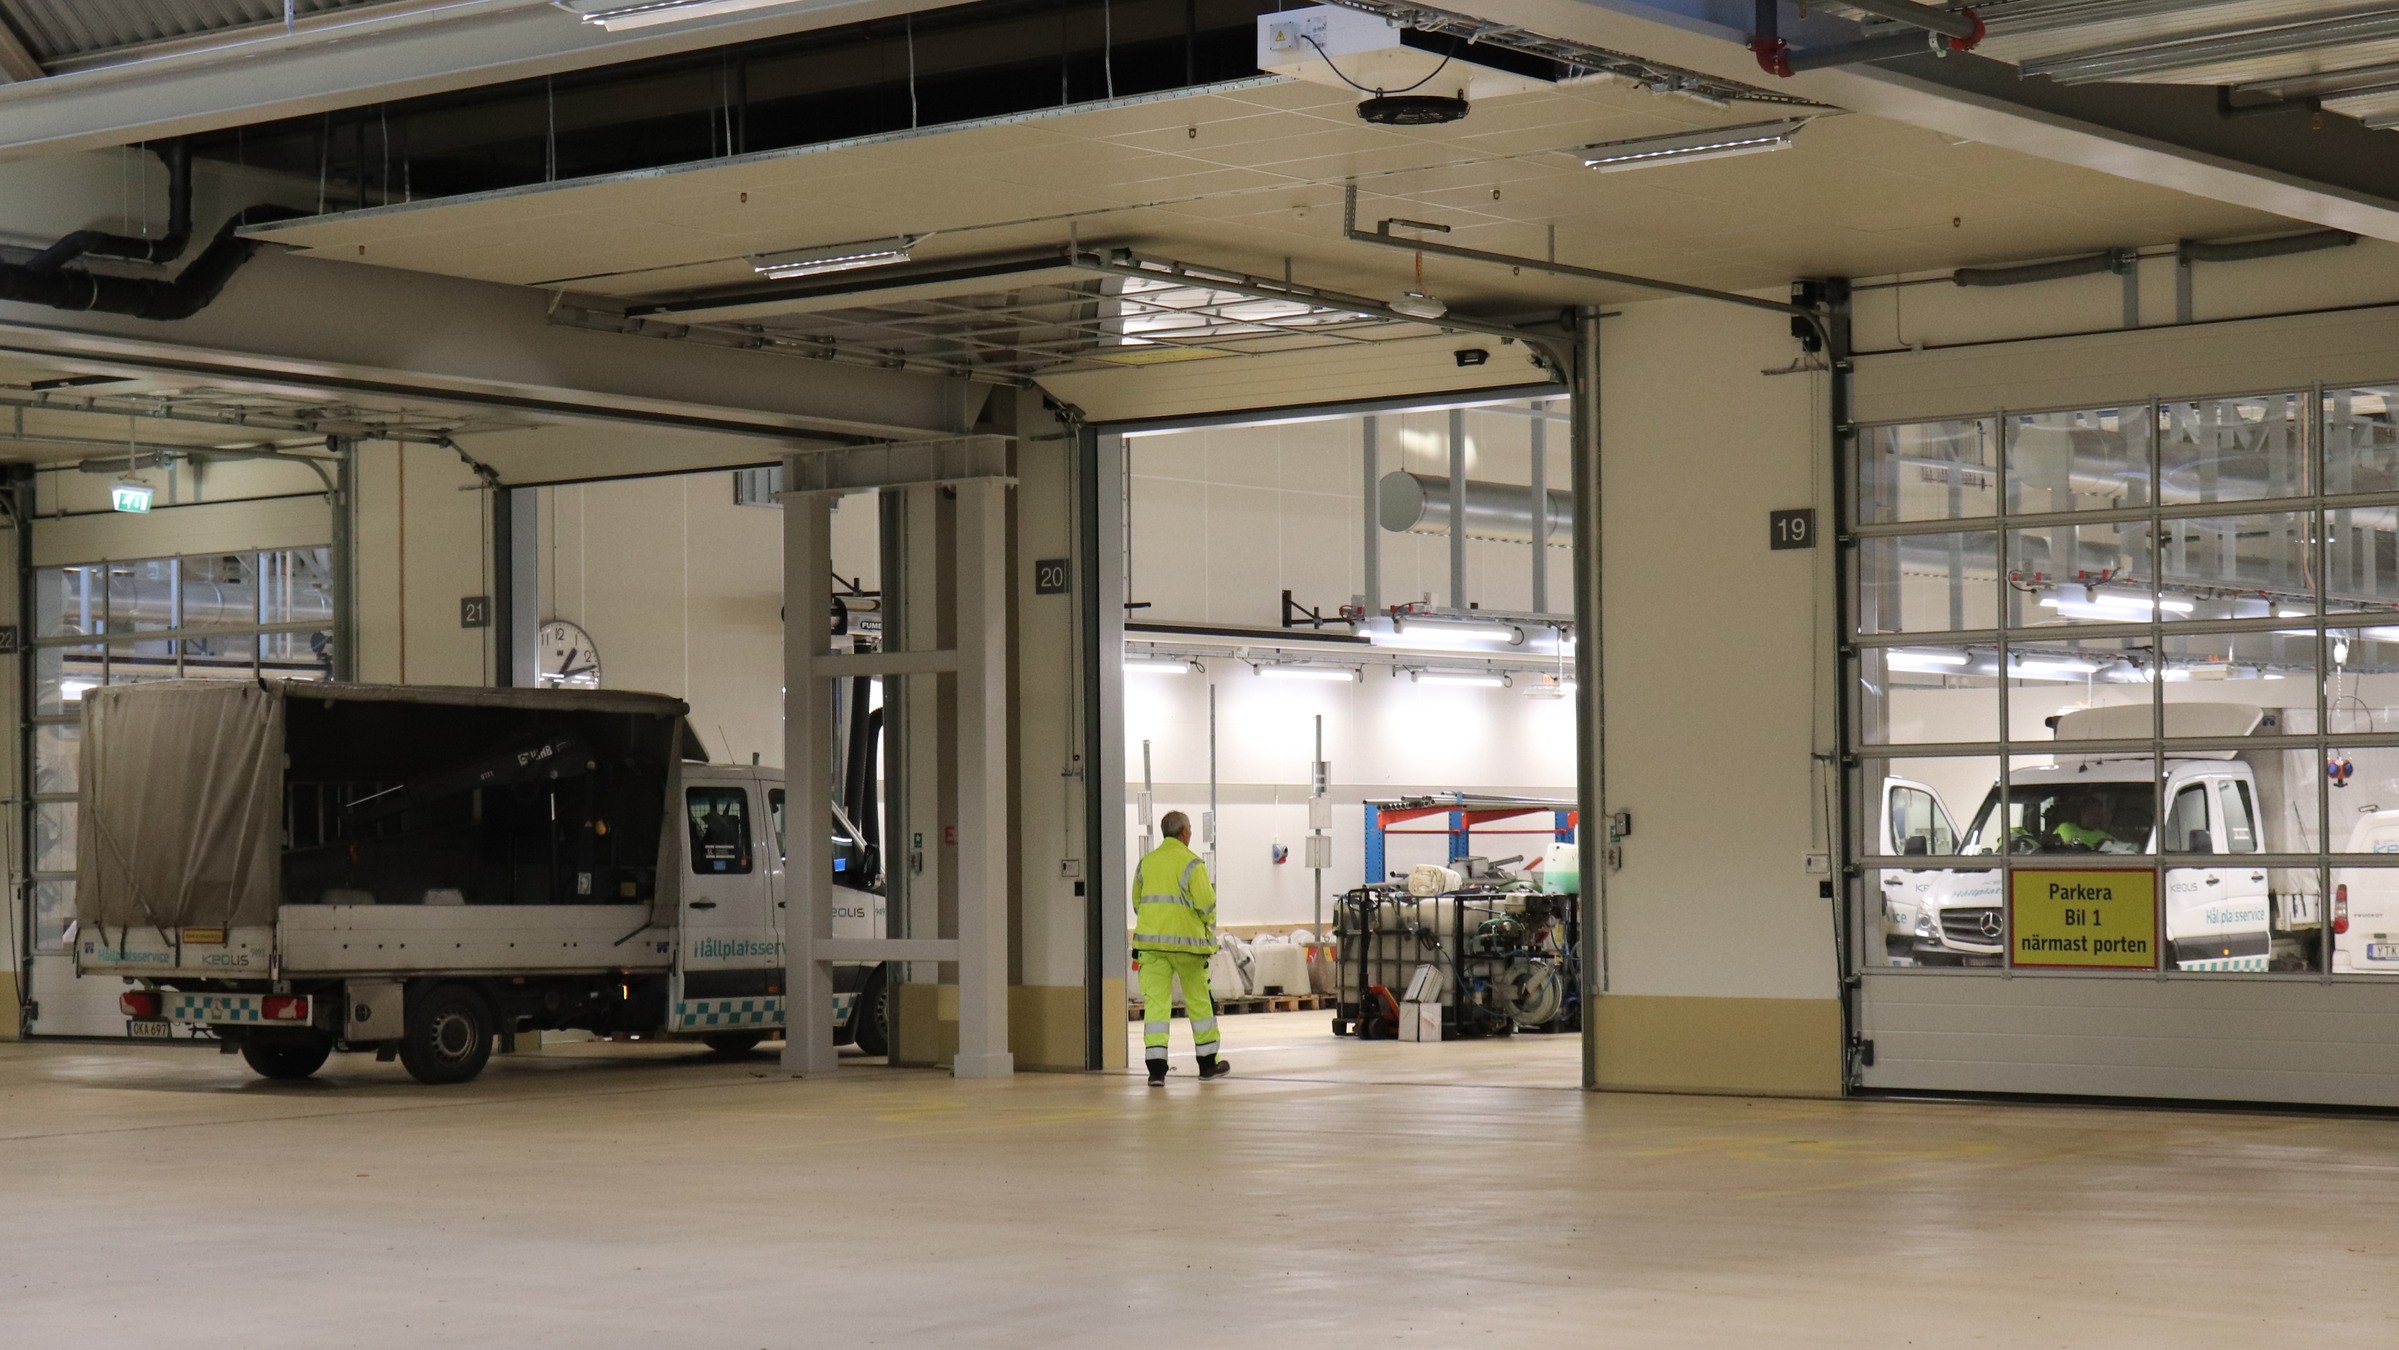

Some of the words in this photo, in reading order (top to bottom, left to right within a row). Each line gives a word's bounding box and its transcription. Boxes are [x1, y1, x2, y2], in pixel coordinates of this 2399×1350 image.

[1778, 518, 1806, 541] 19
[1041, 567, 1063, 587] 20
[466, 603, 483, 621] 21
[555, 628, 565, 641] 12
[583, 650, 592, 663] 2
[2049, 883, 2112, 900] Parkera
[2065, 909, 2085, 926] Bil
[2093, 909, 2102, 926] 1
[2022, 934, 2088, 951] närmast
[2094, 936, 2146, 955] porten
[98, 947, 170, 964] Hållpatsservice
[151, 1023, 167, 1036] 697
